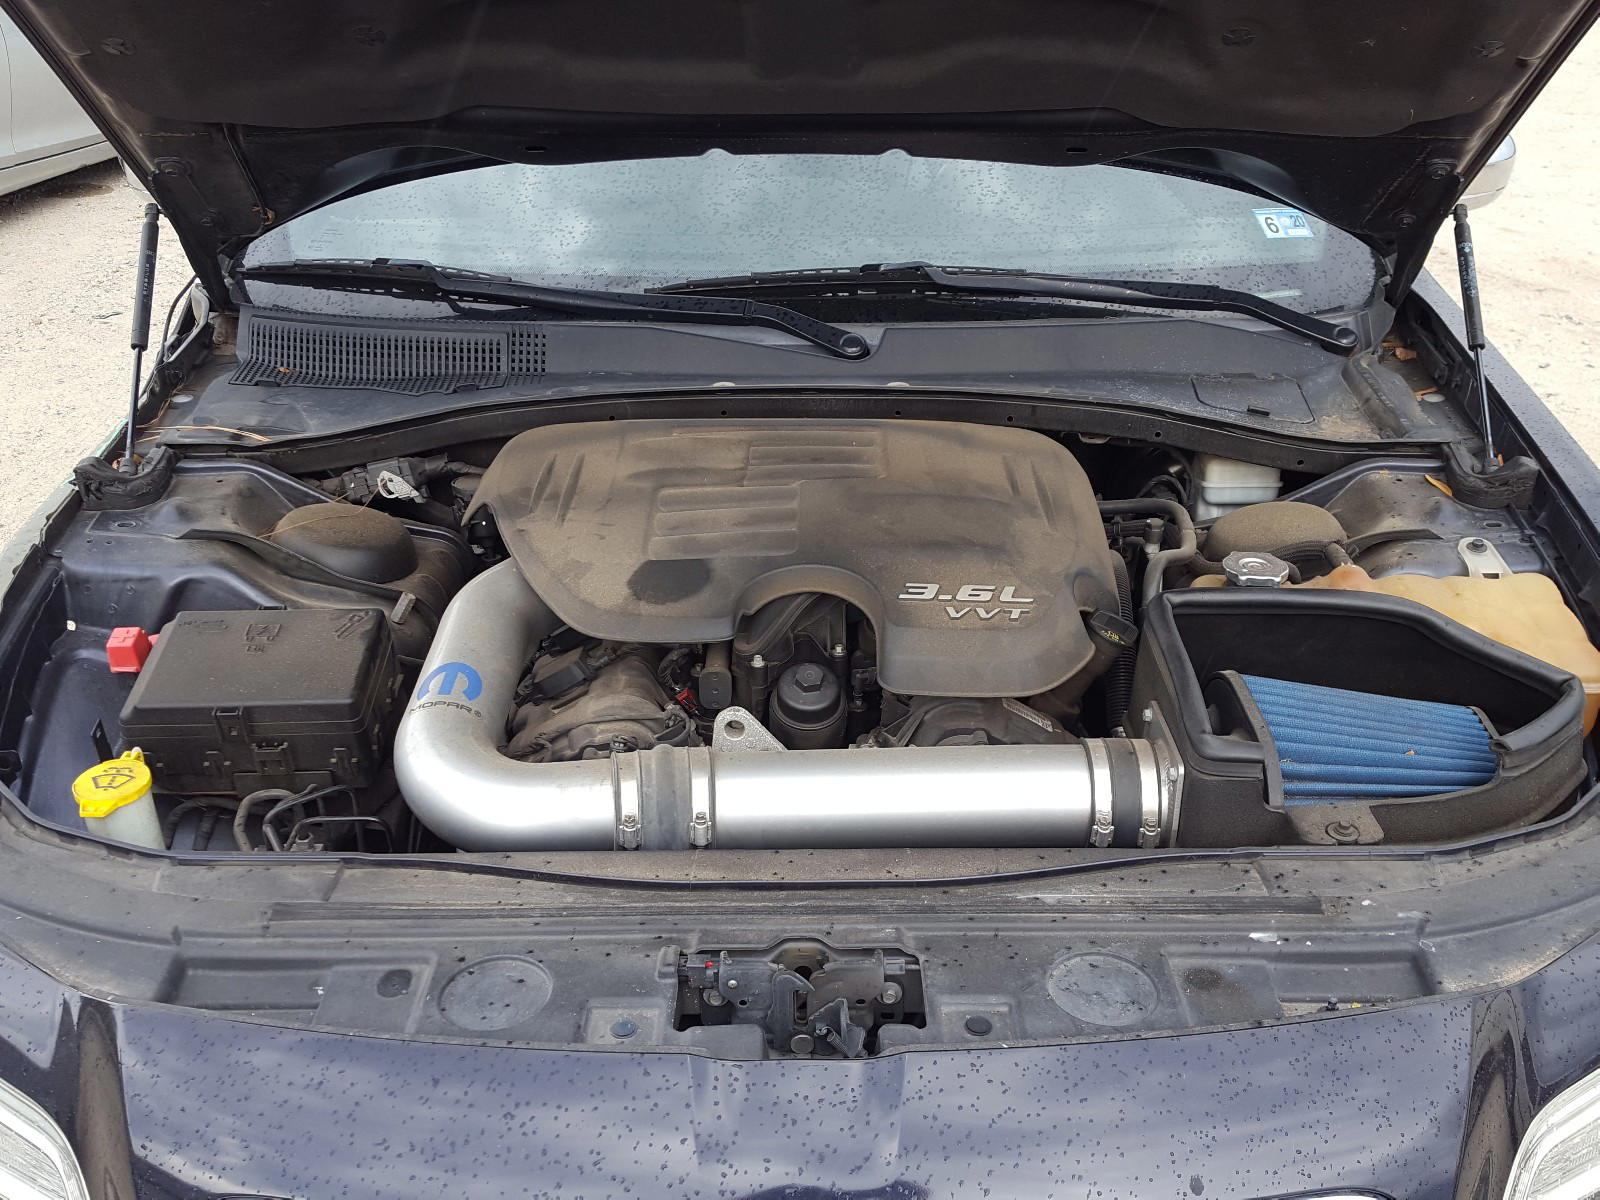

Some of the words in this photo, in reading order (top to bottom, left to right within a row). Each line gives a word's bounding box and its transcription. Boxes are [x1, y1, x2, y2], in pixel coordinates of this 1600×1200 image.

[1264, 216, 1280, 234] 6
[1289, 214, 1306, 228] 20
[898, 583, 1035, 603] 3.6L
[945, 606, 1032, 622] VVT
[409, 700, 473, 715] MOPAR
